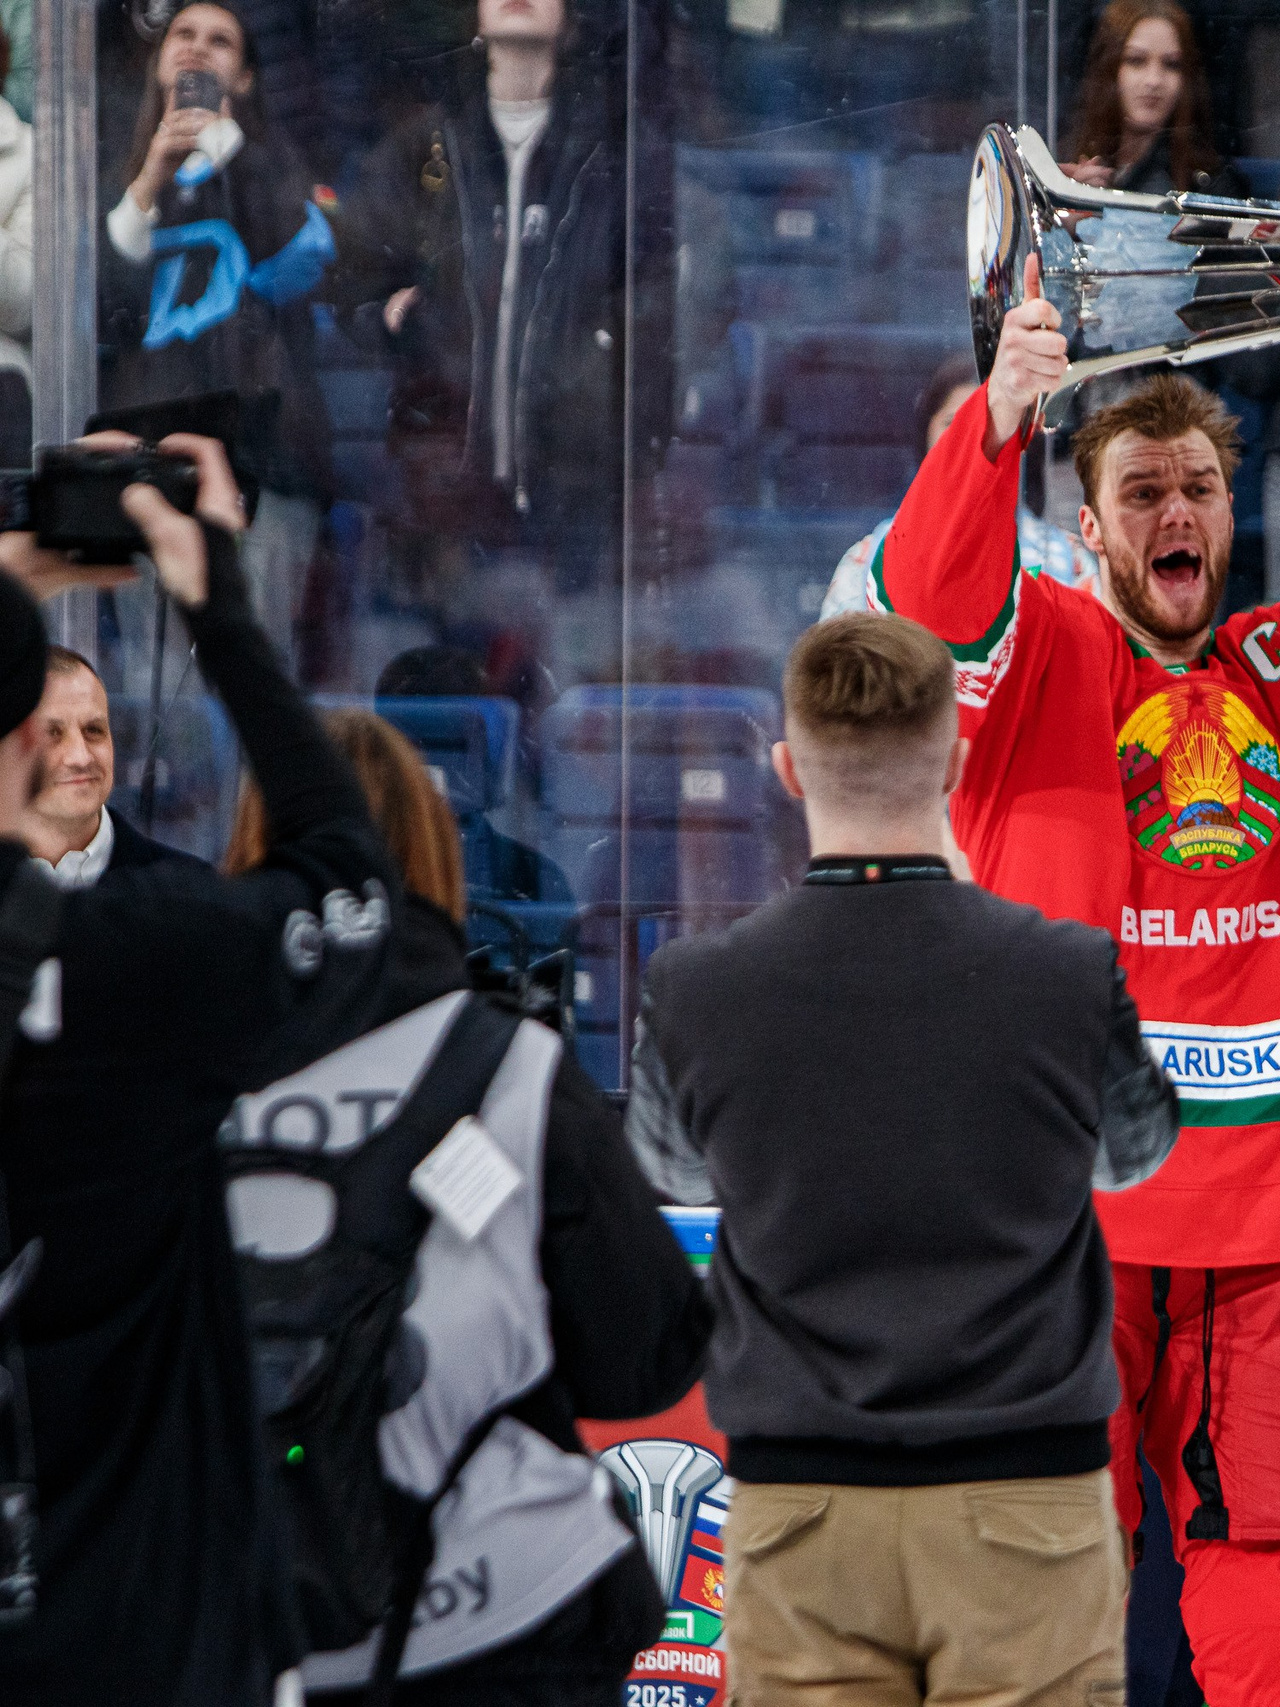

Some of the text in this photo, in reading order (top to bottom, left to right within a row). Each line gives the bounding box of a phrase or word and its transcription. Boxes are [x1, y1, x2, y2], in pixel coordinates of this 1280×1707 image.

[1173, 827, 1242, 846] РЭСПУБЛІКА
[1179, 841, 1239, 859] БЕЛАРУСЬ
[633, 1649, 721, 1679] СБОРНОЙ
[625, 1684, 688, 1707] 2025
